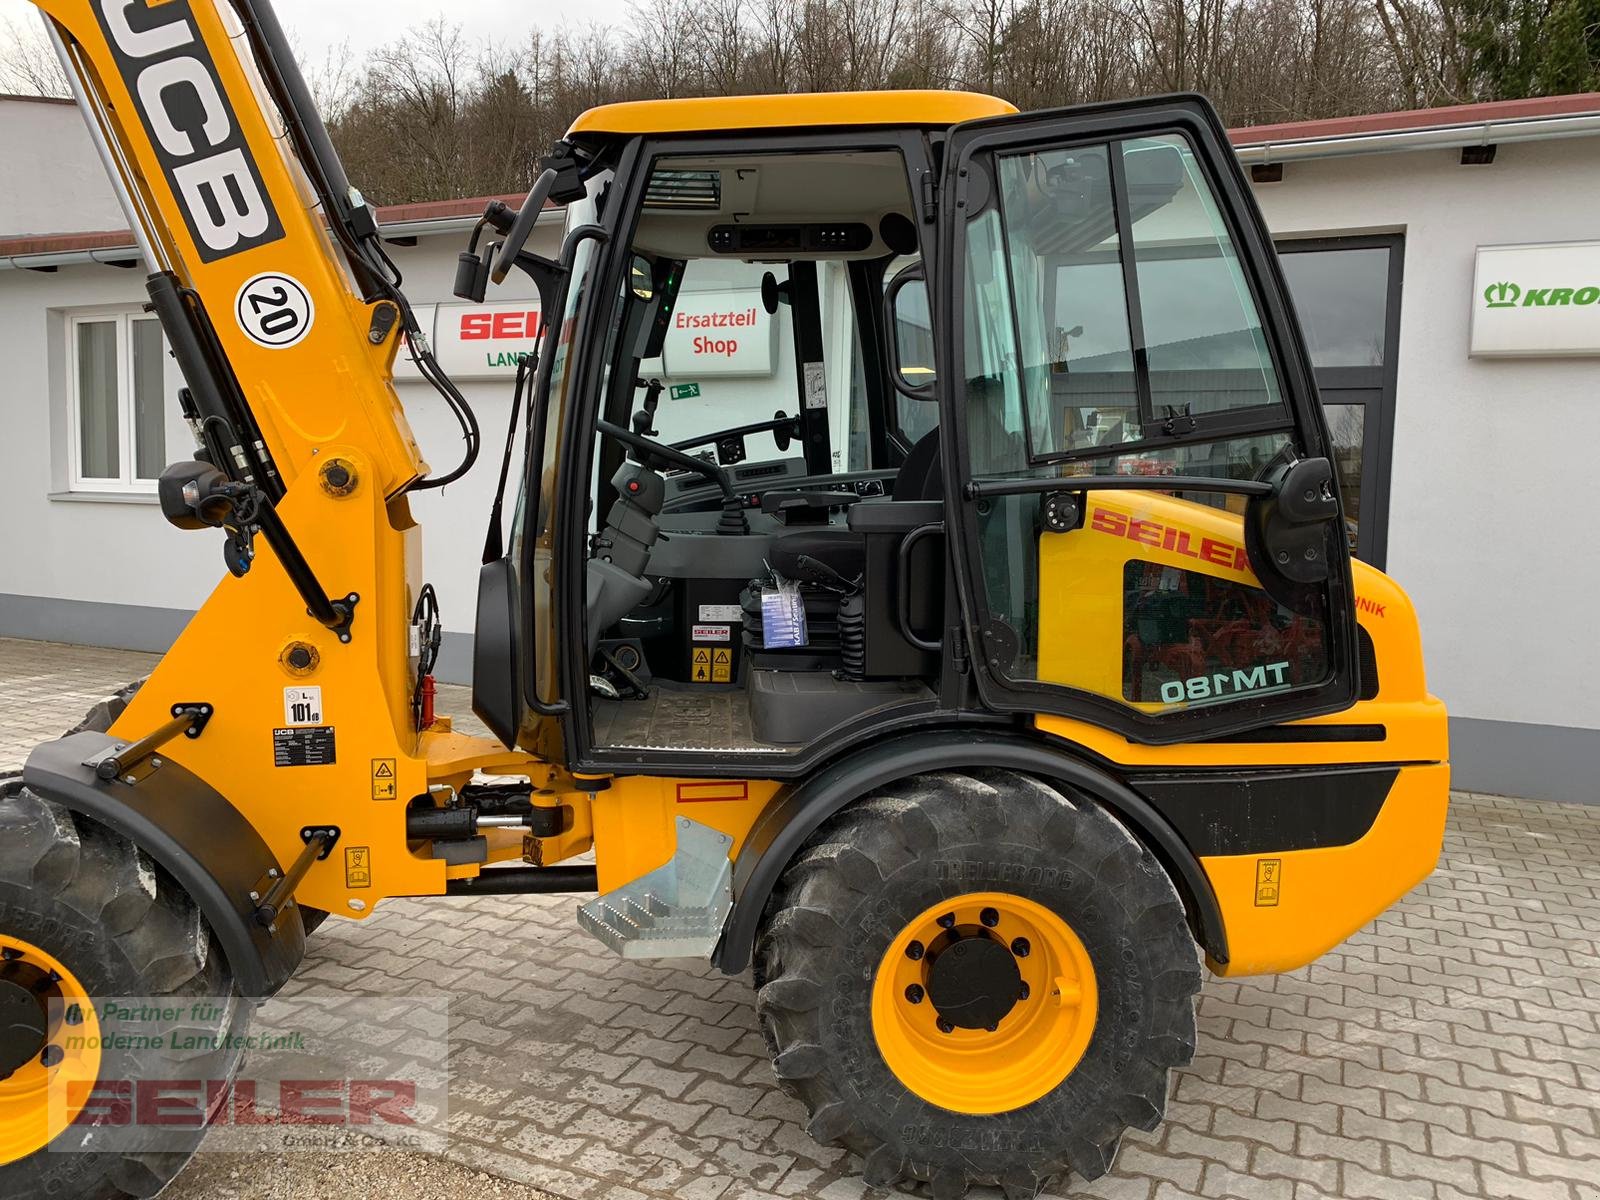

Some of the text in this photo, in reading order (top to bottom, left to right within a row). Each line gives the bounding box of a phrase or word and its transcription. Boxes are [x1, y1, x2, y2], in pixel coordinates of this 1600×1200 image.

[102, 0, 269, 250] JCB
[1522, 286, 1600, 307] KRO
[247, 285, 299, 336] 20
[676, 308, 757, 328] Ersatzteil
[460, 311, 546, 340] SEI
[693, 336, 738, 357] Shop
[302, 692, 308, 700] L
[291, 703, 320, 722] 101 dB
